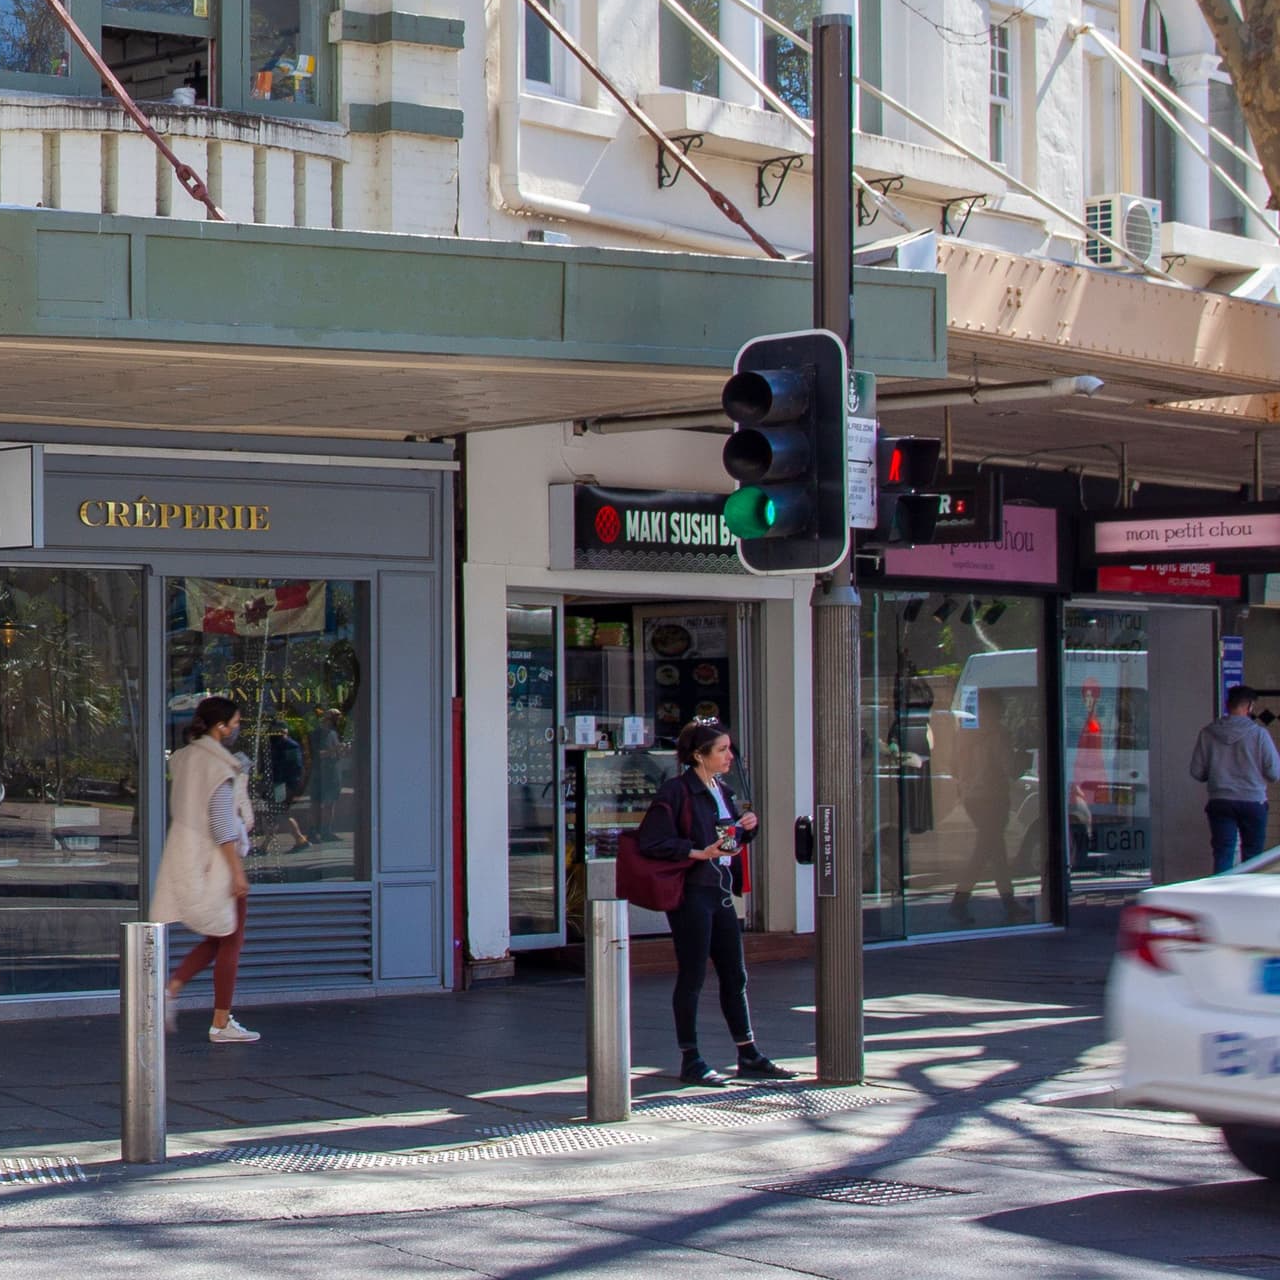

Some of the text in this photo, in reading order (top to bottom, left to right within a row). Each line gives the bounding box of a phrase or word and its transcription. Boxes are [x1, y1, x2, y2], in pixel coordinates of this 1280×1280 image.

[79, 495, 271, 531] CRÊPERIE
[626, 510, 667, 543] MAKI
[669, 512, 716, 545] SUSHI
[1126, 521, 1252, 542] mon petit chou
[1106, 830, 1145, 850] can
